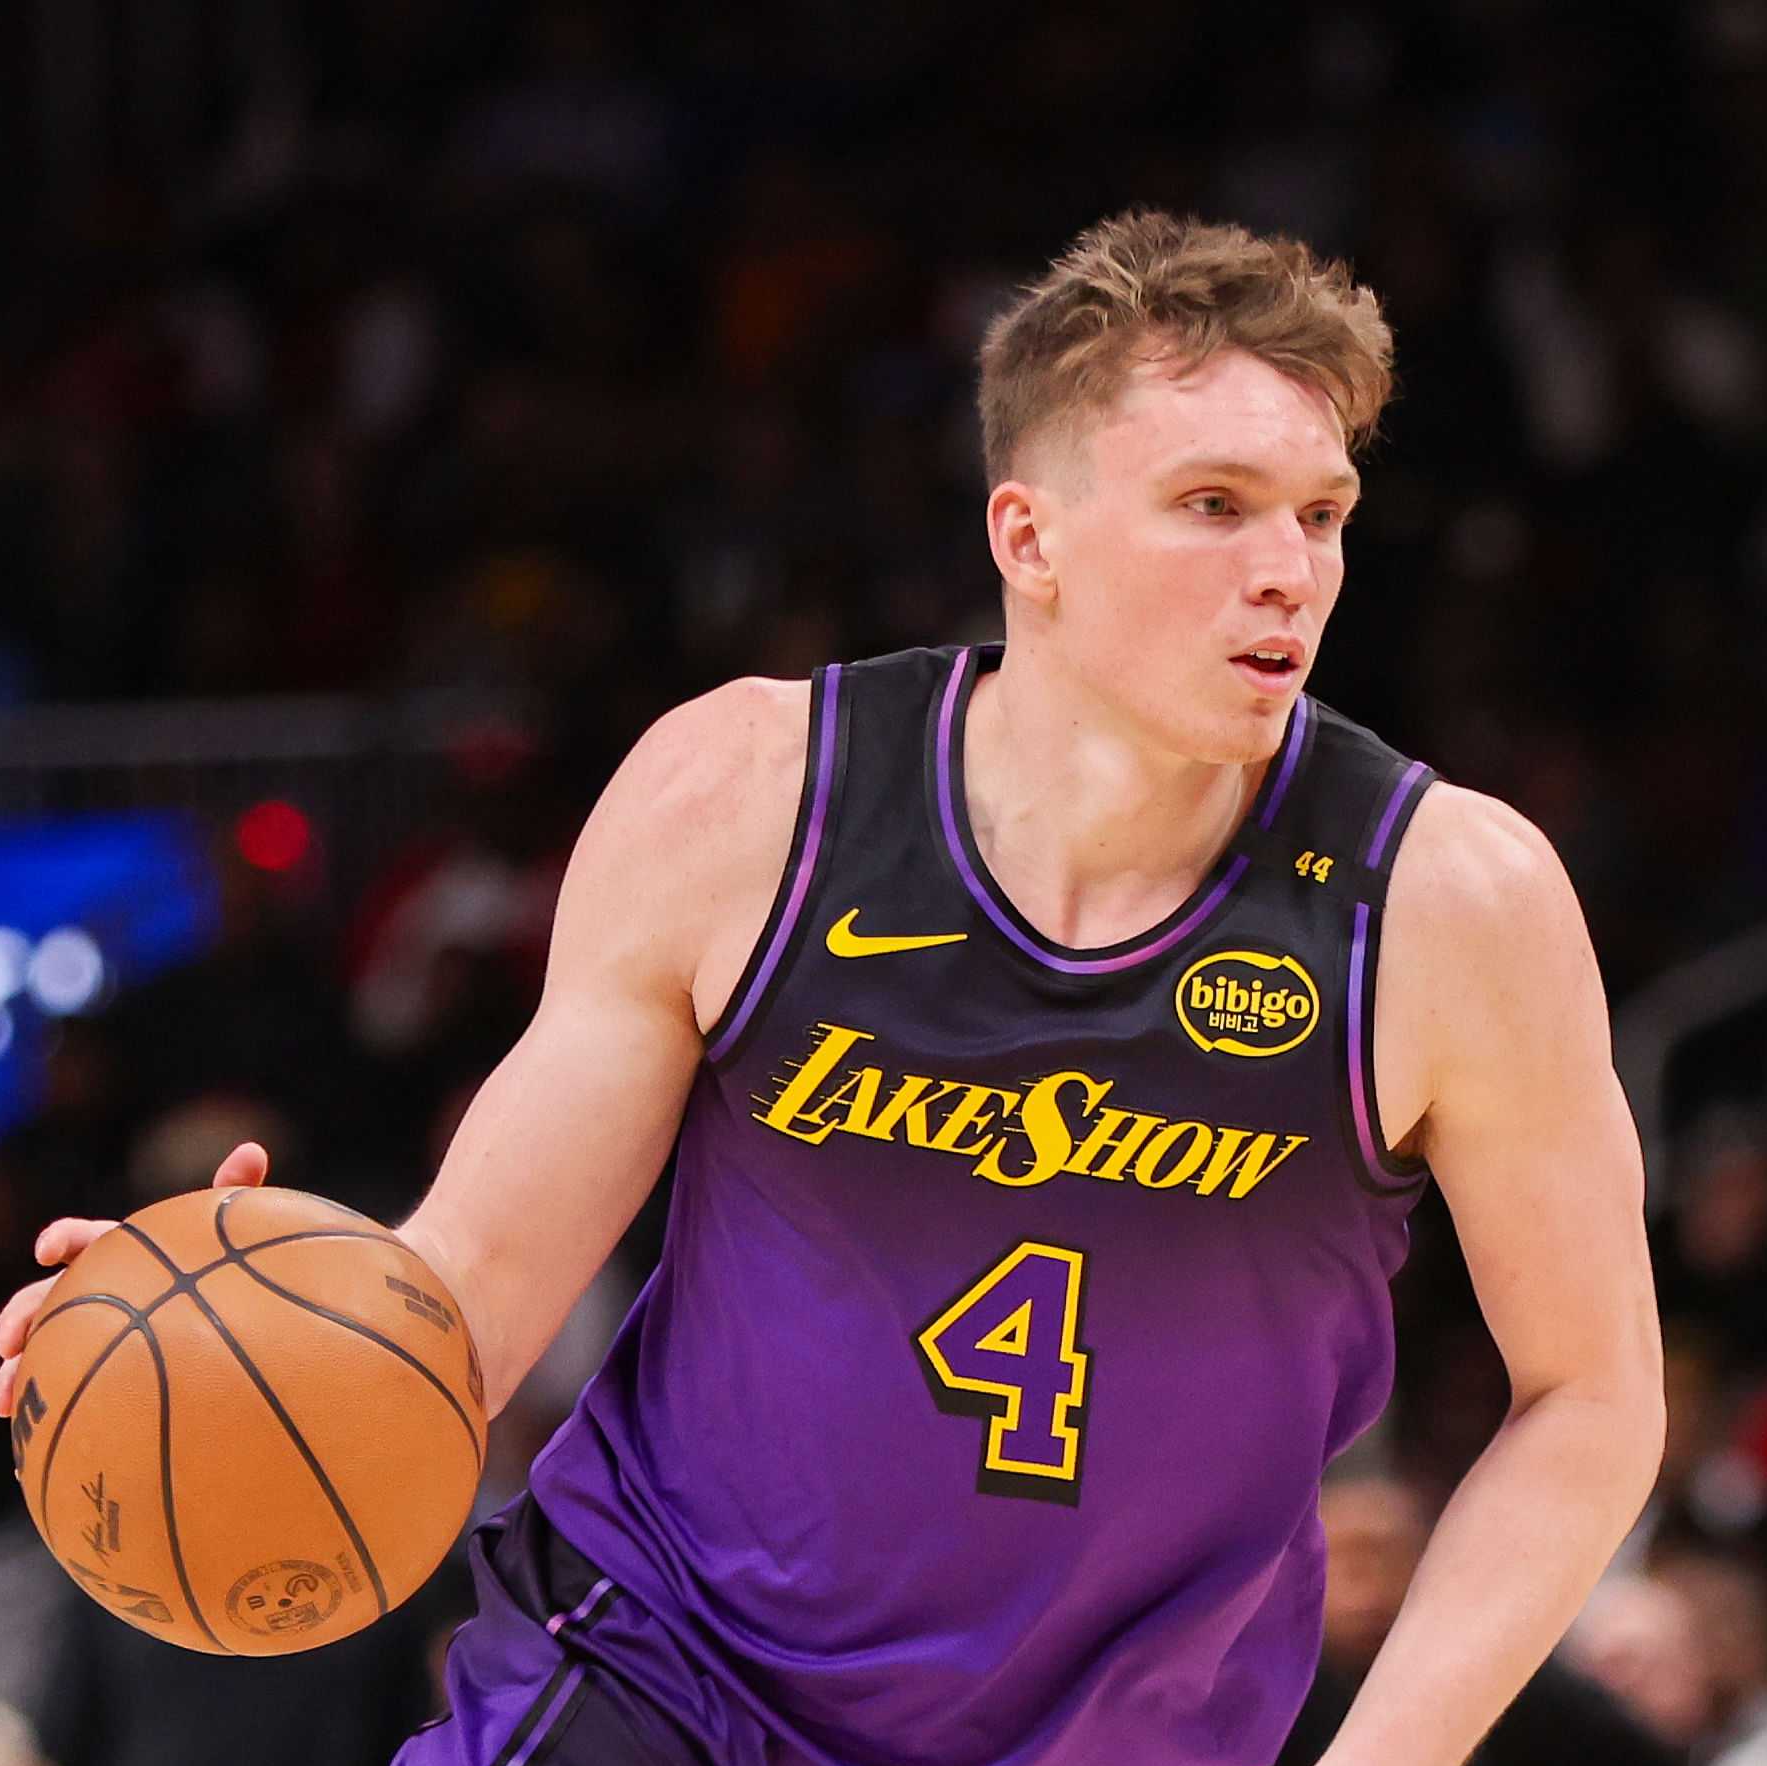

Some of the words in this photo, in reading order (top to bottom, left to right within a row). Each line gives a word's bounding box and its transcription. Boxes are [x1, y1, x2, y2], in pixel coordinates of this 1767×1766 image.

[1294, 850, 1335, 885] 44
[1189, 975, 1311, 1029] bibigo
[1208, 1011, 1259, 1034] 비비고
[914, 1239, 1088, 1490] 4
